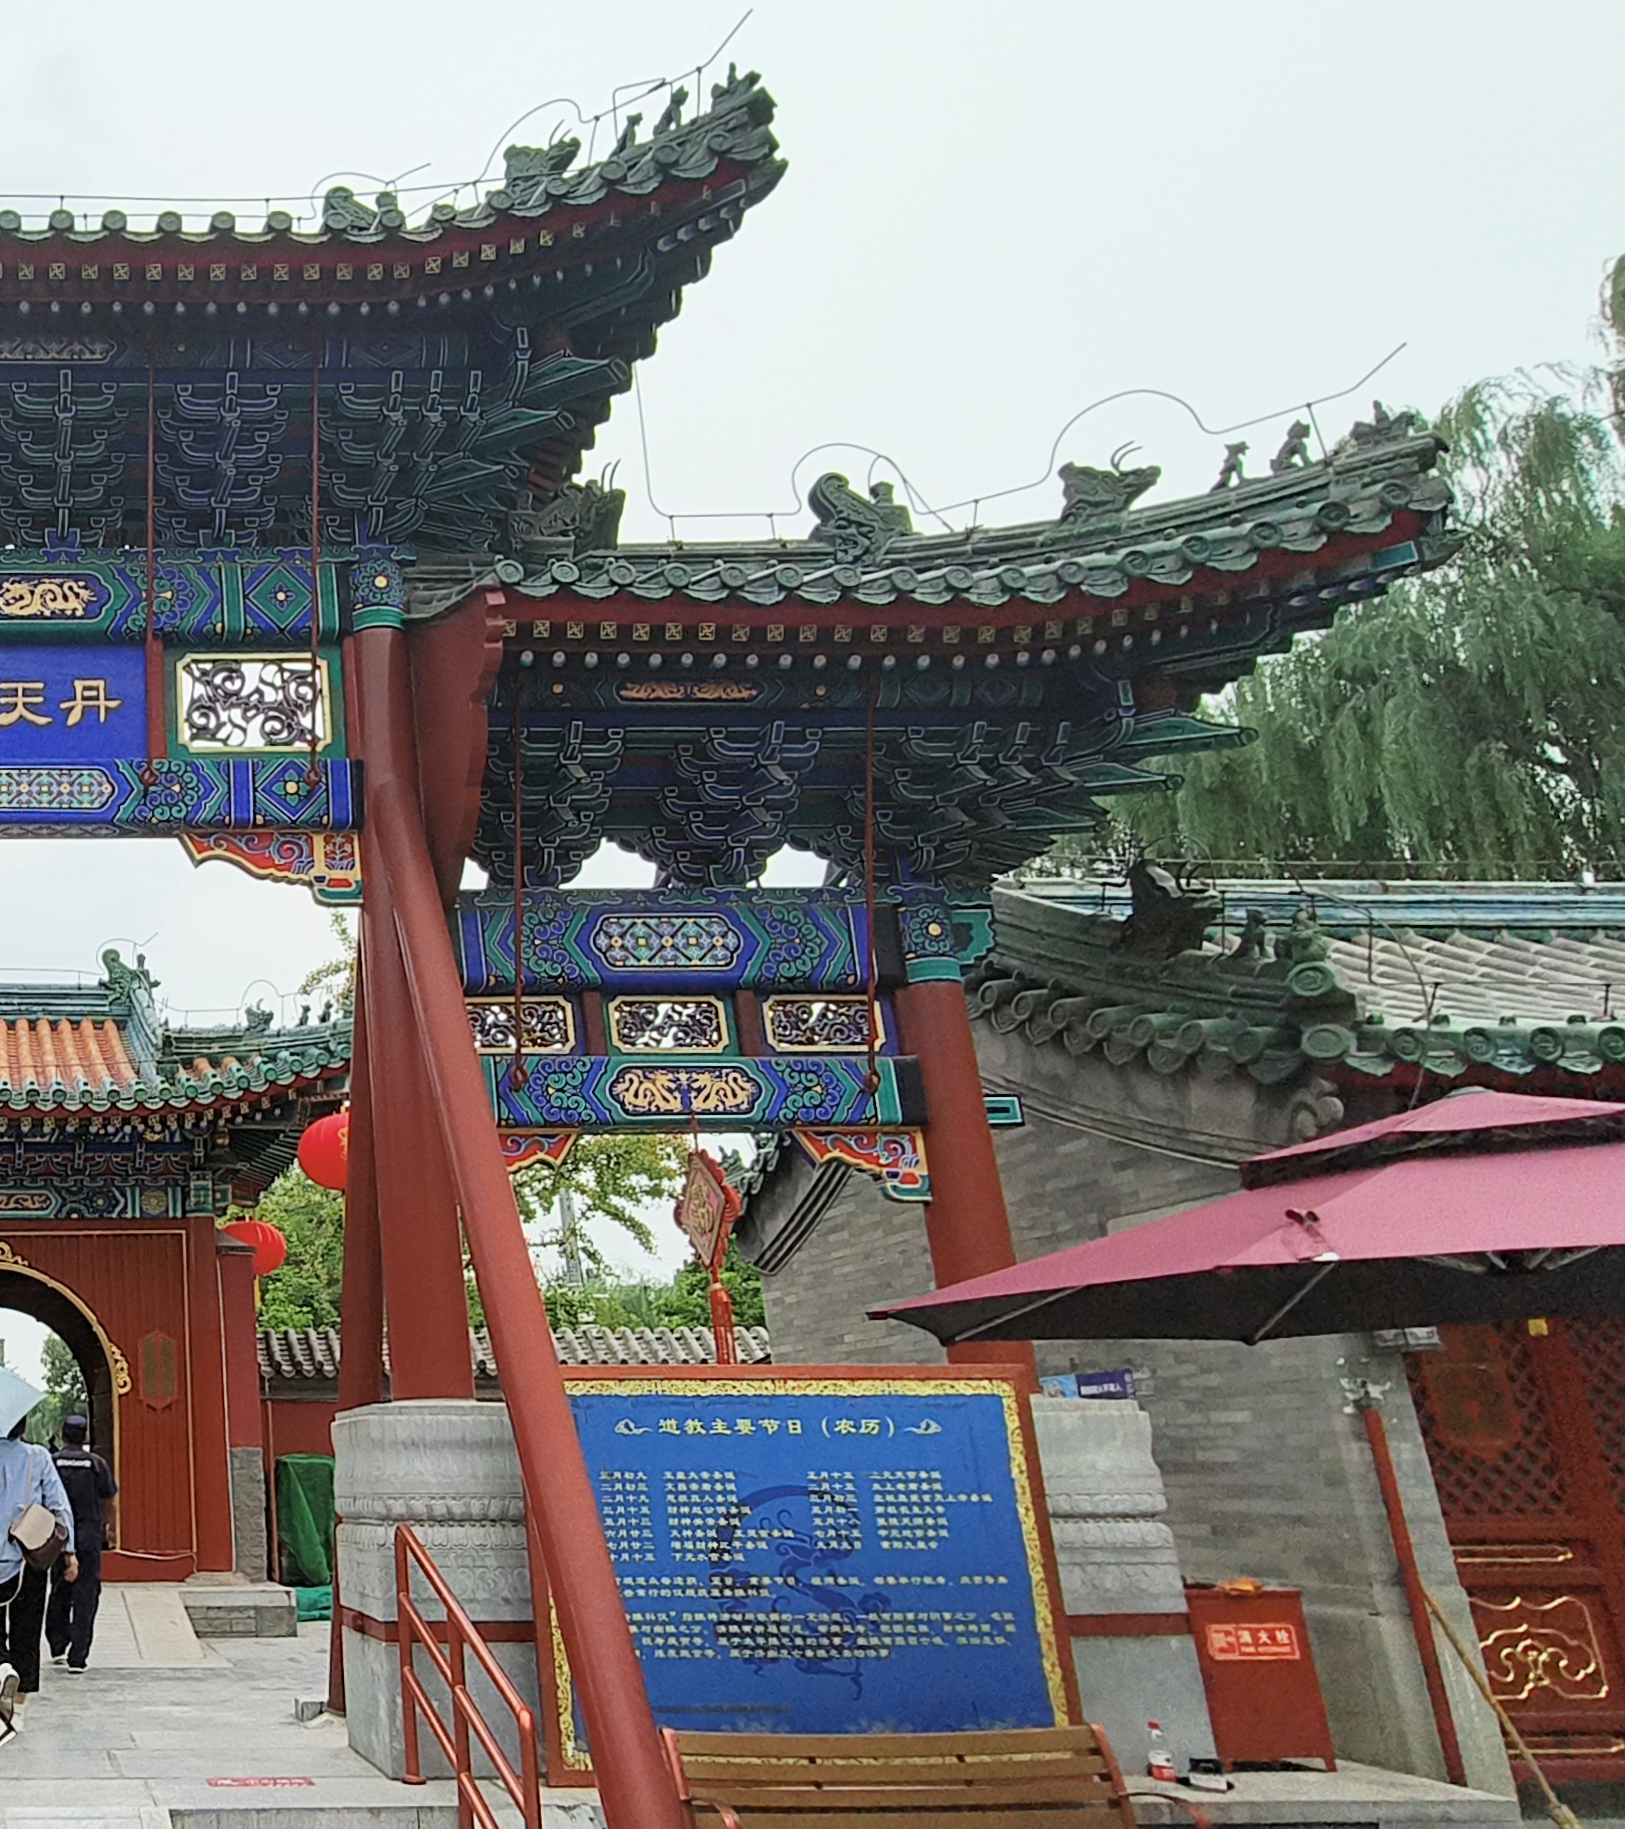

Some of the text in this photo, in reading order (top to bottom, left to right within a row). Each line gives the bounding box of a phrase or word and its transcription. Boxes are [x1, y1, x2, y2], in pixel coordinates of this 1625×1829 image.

[657, 1416, 896, 1438] 道教主要节日（农历）
